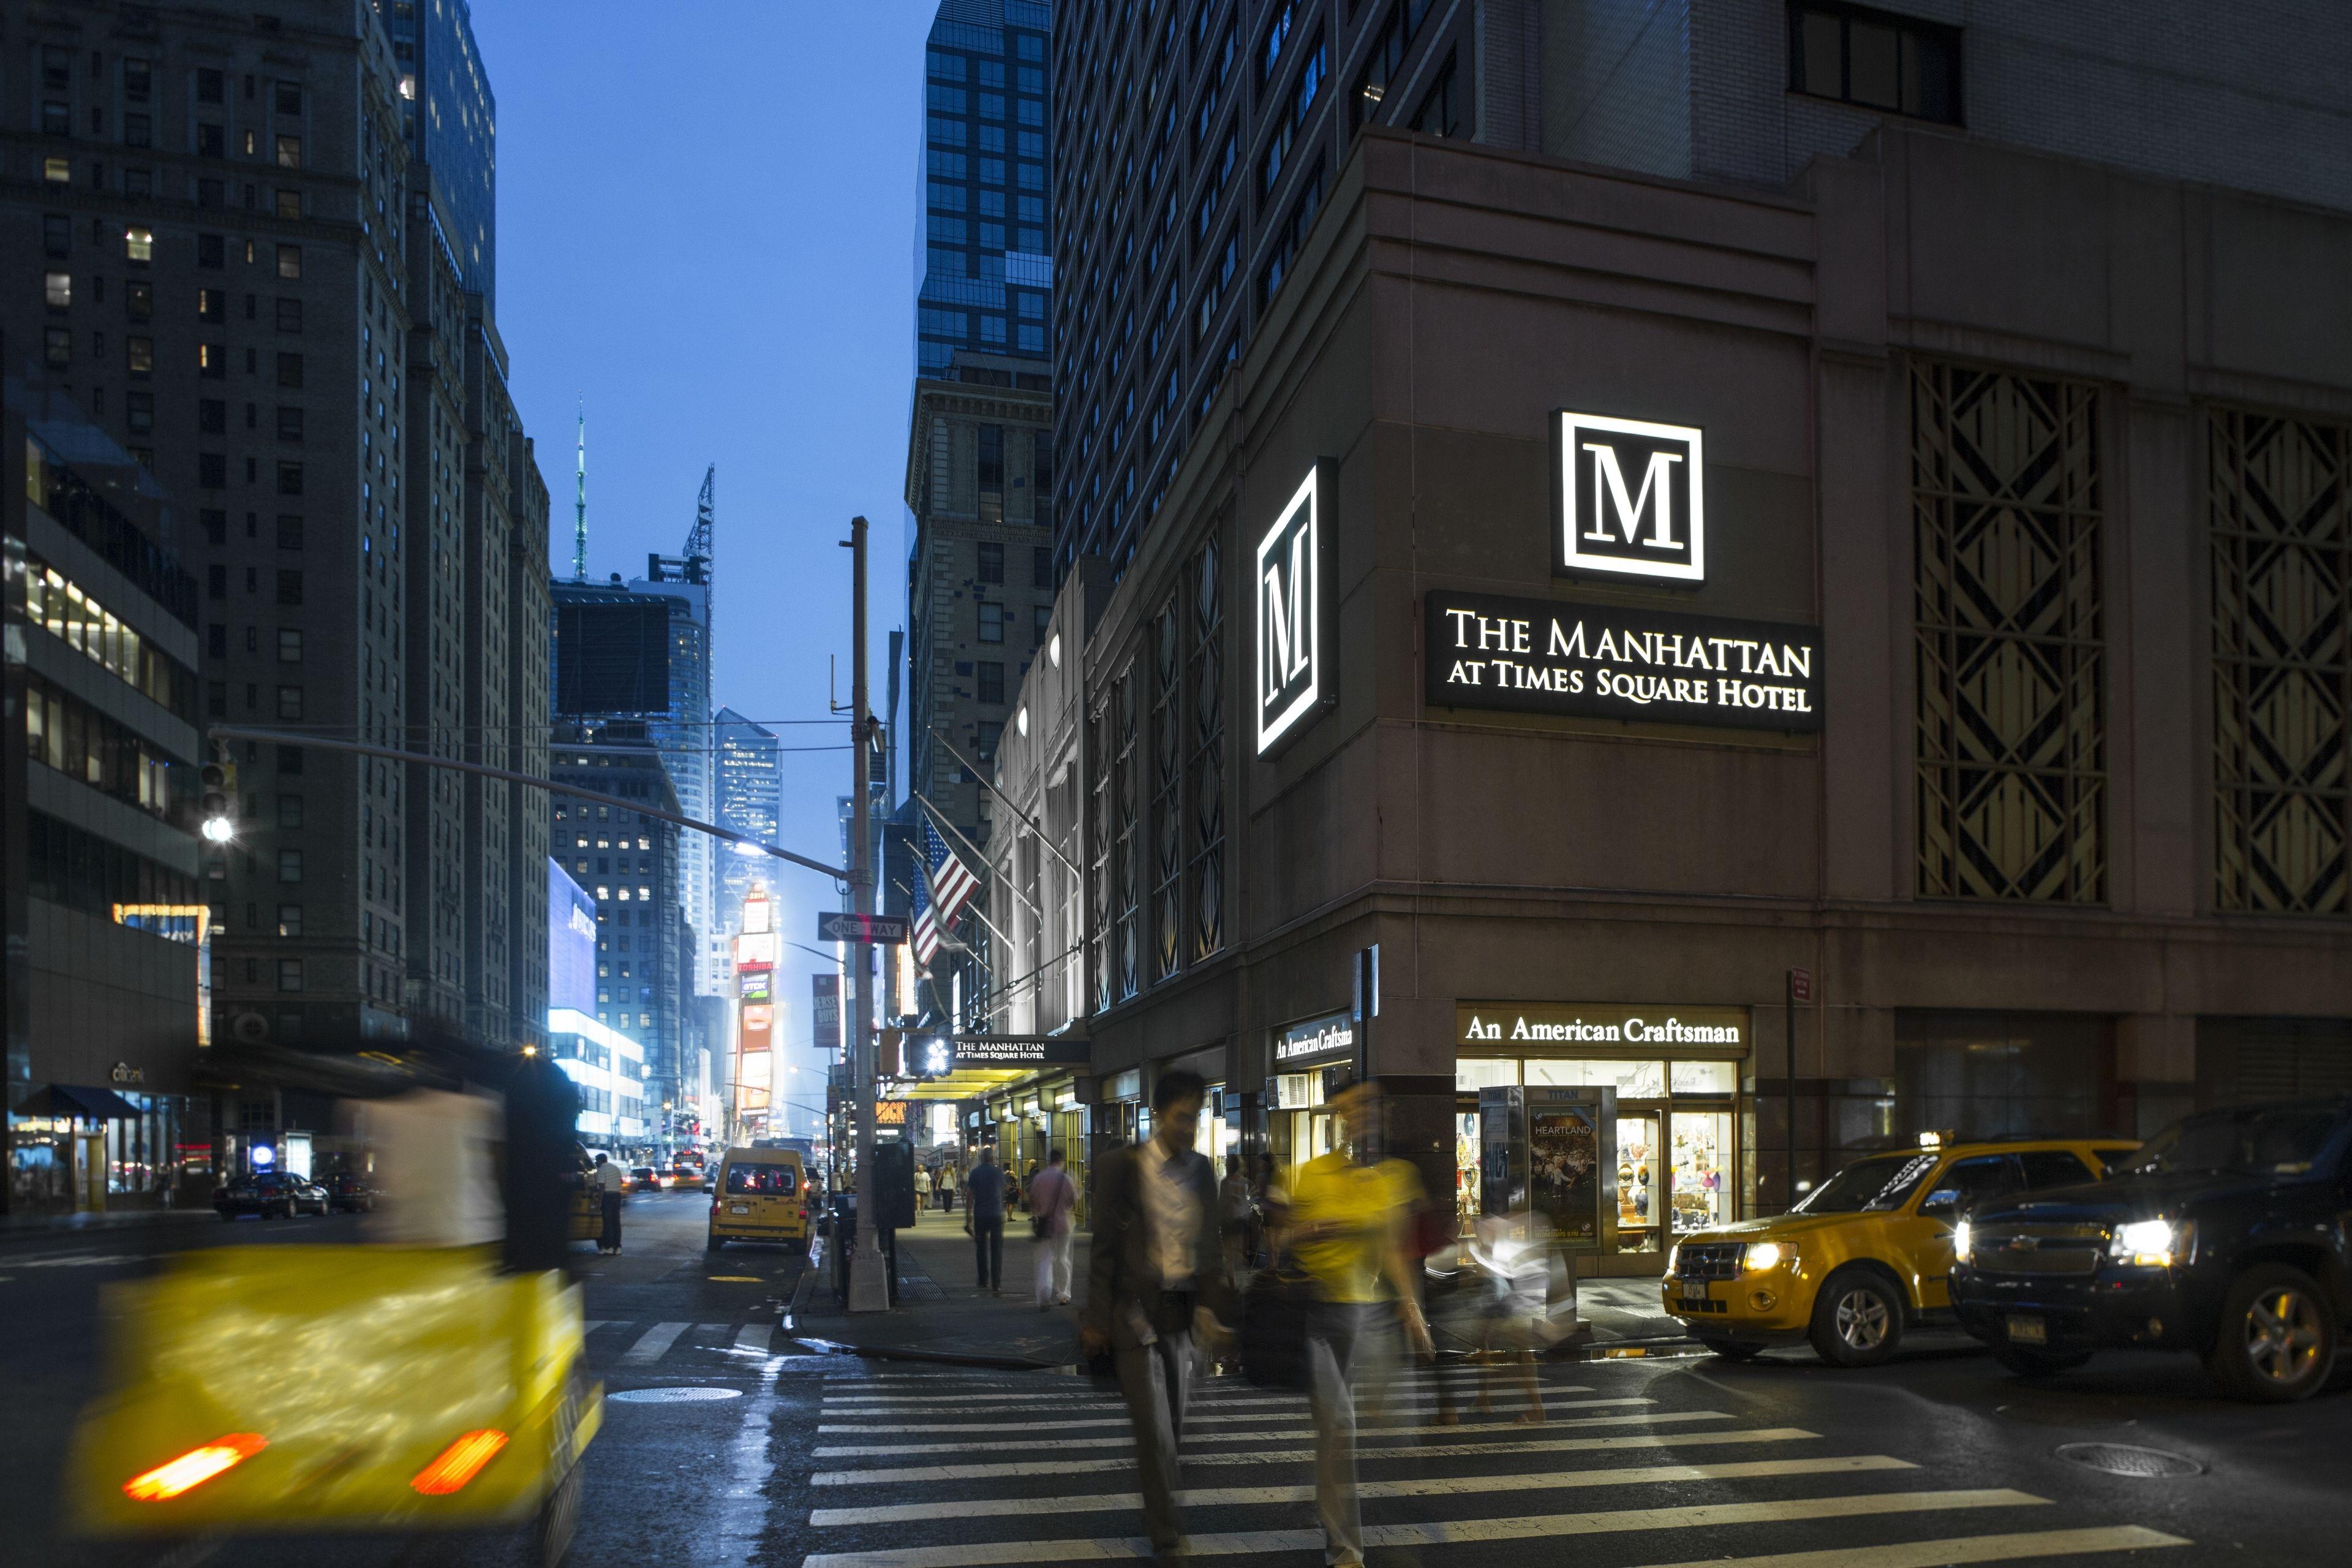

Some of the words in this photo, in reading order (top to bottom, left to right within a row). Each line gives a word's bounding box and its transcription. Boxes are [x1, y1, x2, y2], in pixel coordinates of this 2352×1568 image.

[1583, 443, 1683, 549] M
[1265, 522, 1308, 706] M
[1446, 608, 1530, 653] THE
[1547, 618, 1811, 678] MANHATTAN
[1447, 660, 1485, 685] AT
[1491, 659, 1583, 693] TIMES
[1597, 669, 1708, 704] SQUARE
[1717, 679, 1811, 712] HOTEL
[833, 922, 858, 933] ONE
[871, 924, 896, 935] WAY
[738, 963, 772, 971] TOSHIBA
[818, 1008, 839, 1023] BOYS
[1276, 1040, 1286, 1059] An
[1287, 1035, 1319, 1057] American
[1319, 1025, 1352, 1050] Craftsma
[1466, 1016, 1501, 1039] An
[1510, 1016, 1619, 1041] American
[1624, 1018, 1740, 1042] Craftsman
[956, 1042, 976, 1051] THE
[979, 1042, 1044, 1051] MANHATTAN
[1548, 1090, 1578, 1100] TITAN
